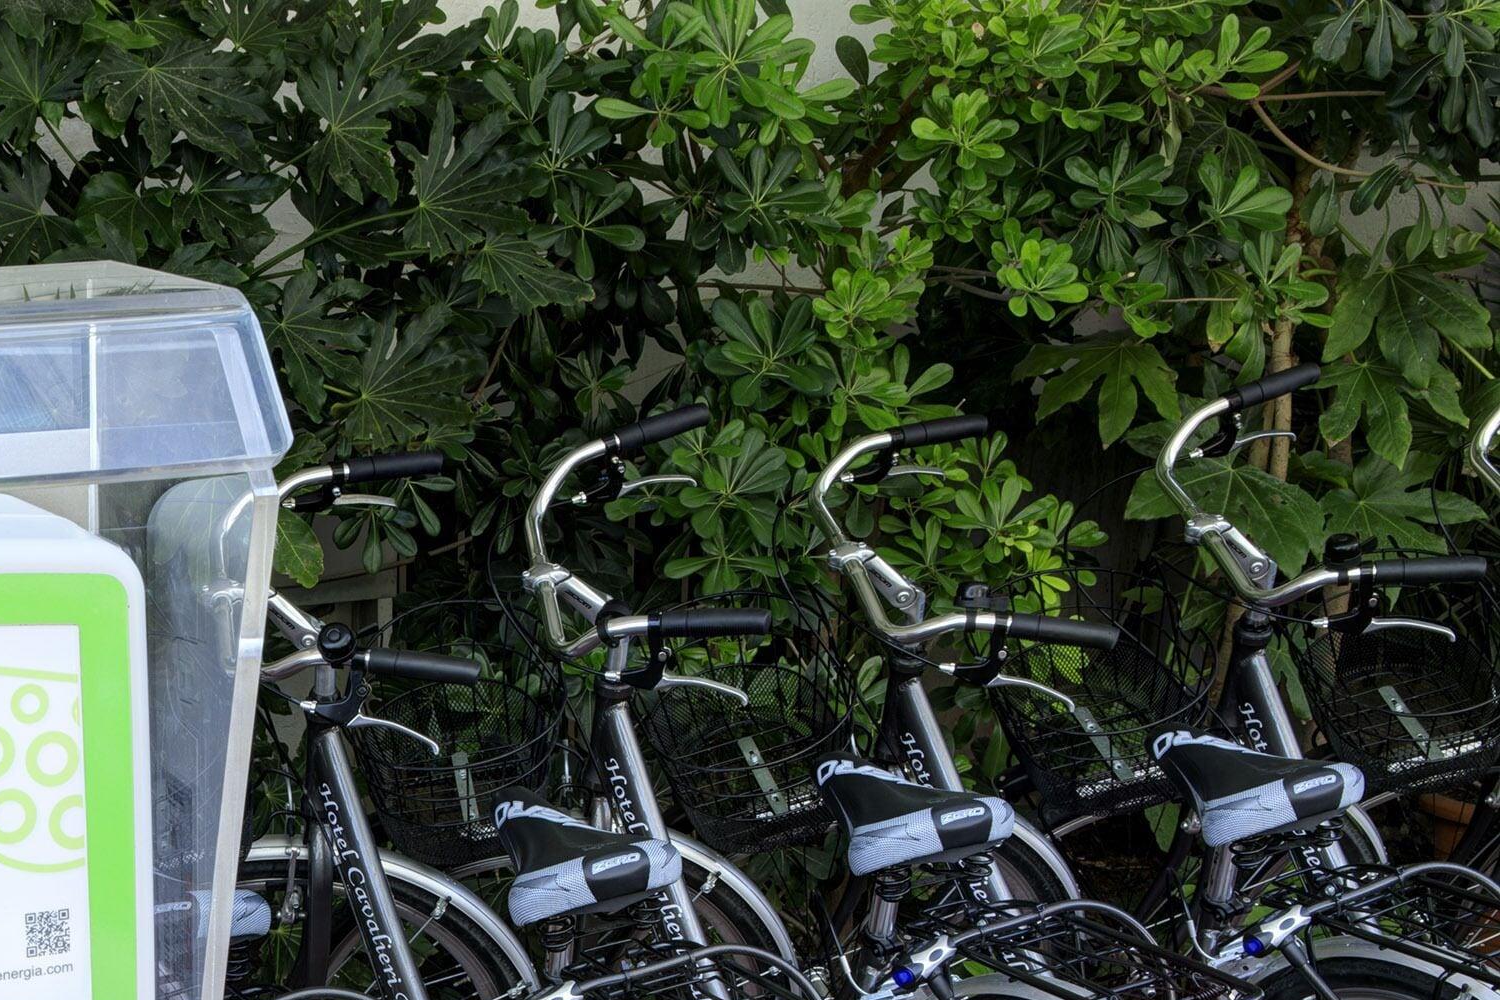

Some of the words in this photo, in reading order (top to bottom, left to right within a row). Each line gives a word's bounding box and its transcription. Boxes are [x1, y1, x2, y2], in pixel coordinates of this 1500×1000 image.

[900, 732, 934, 789] Hot
[1238, 702, 1268, 752] Hot
[604, 757, 649, 834] Hotel
[318, 782, 360, 861] Hotel
[348, 866, 402, 988] Cavalieri
